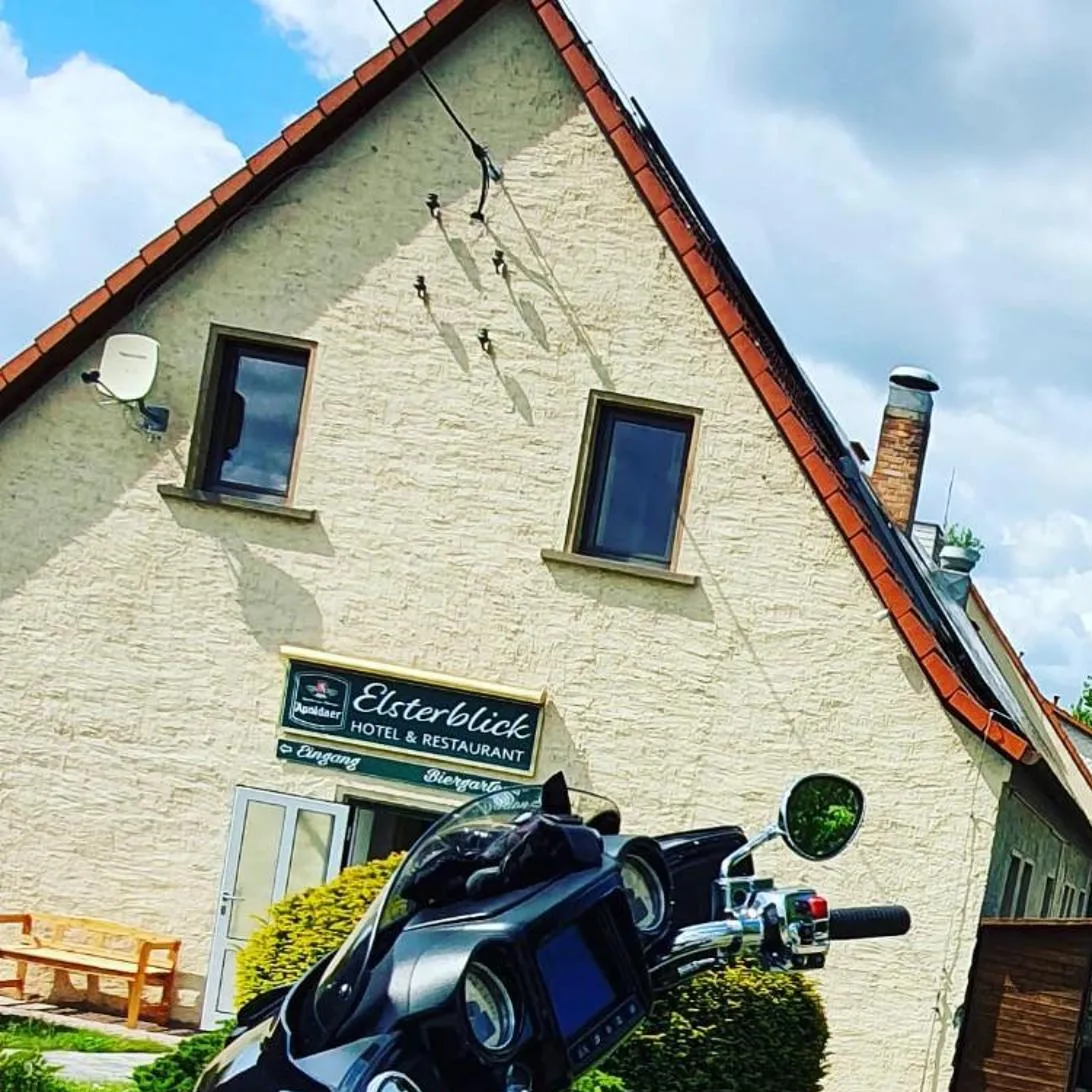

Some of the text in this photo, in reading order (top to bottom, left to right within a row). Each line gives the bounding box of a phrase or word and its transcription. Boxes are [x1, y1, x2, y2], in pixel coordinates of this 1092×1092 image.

[352, 682, 532, 740] Elsterblick
[296, 745, 361, 771] Eingang
[350, 720, 525, 762] HOTEL & RESTAURANT
[423, 768, 503, 794] Biergarte
